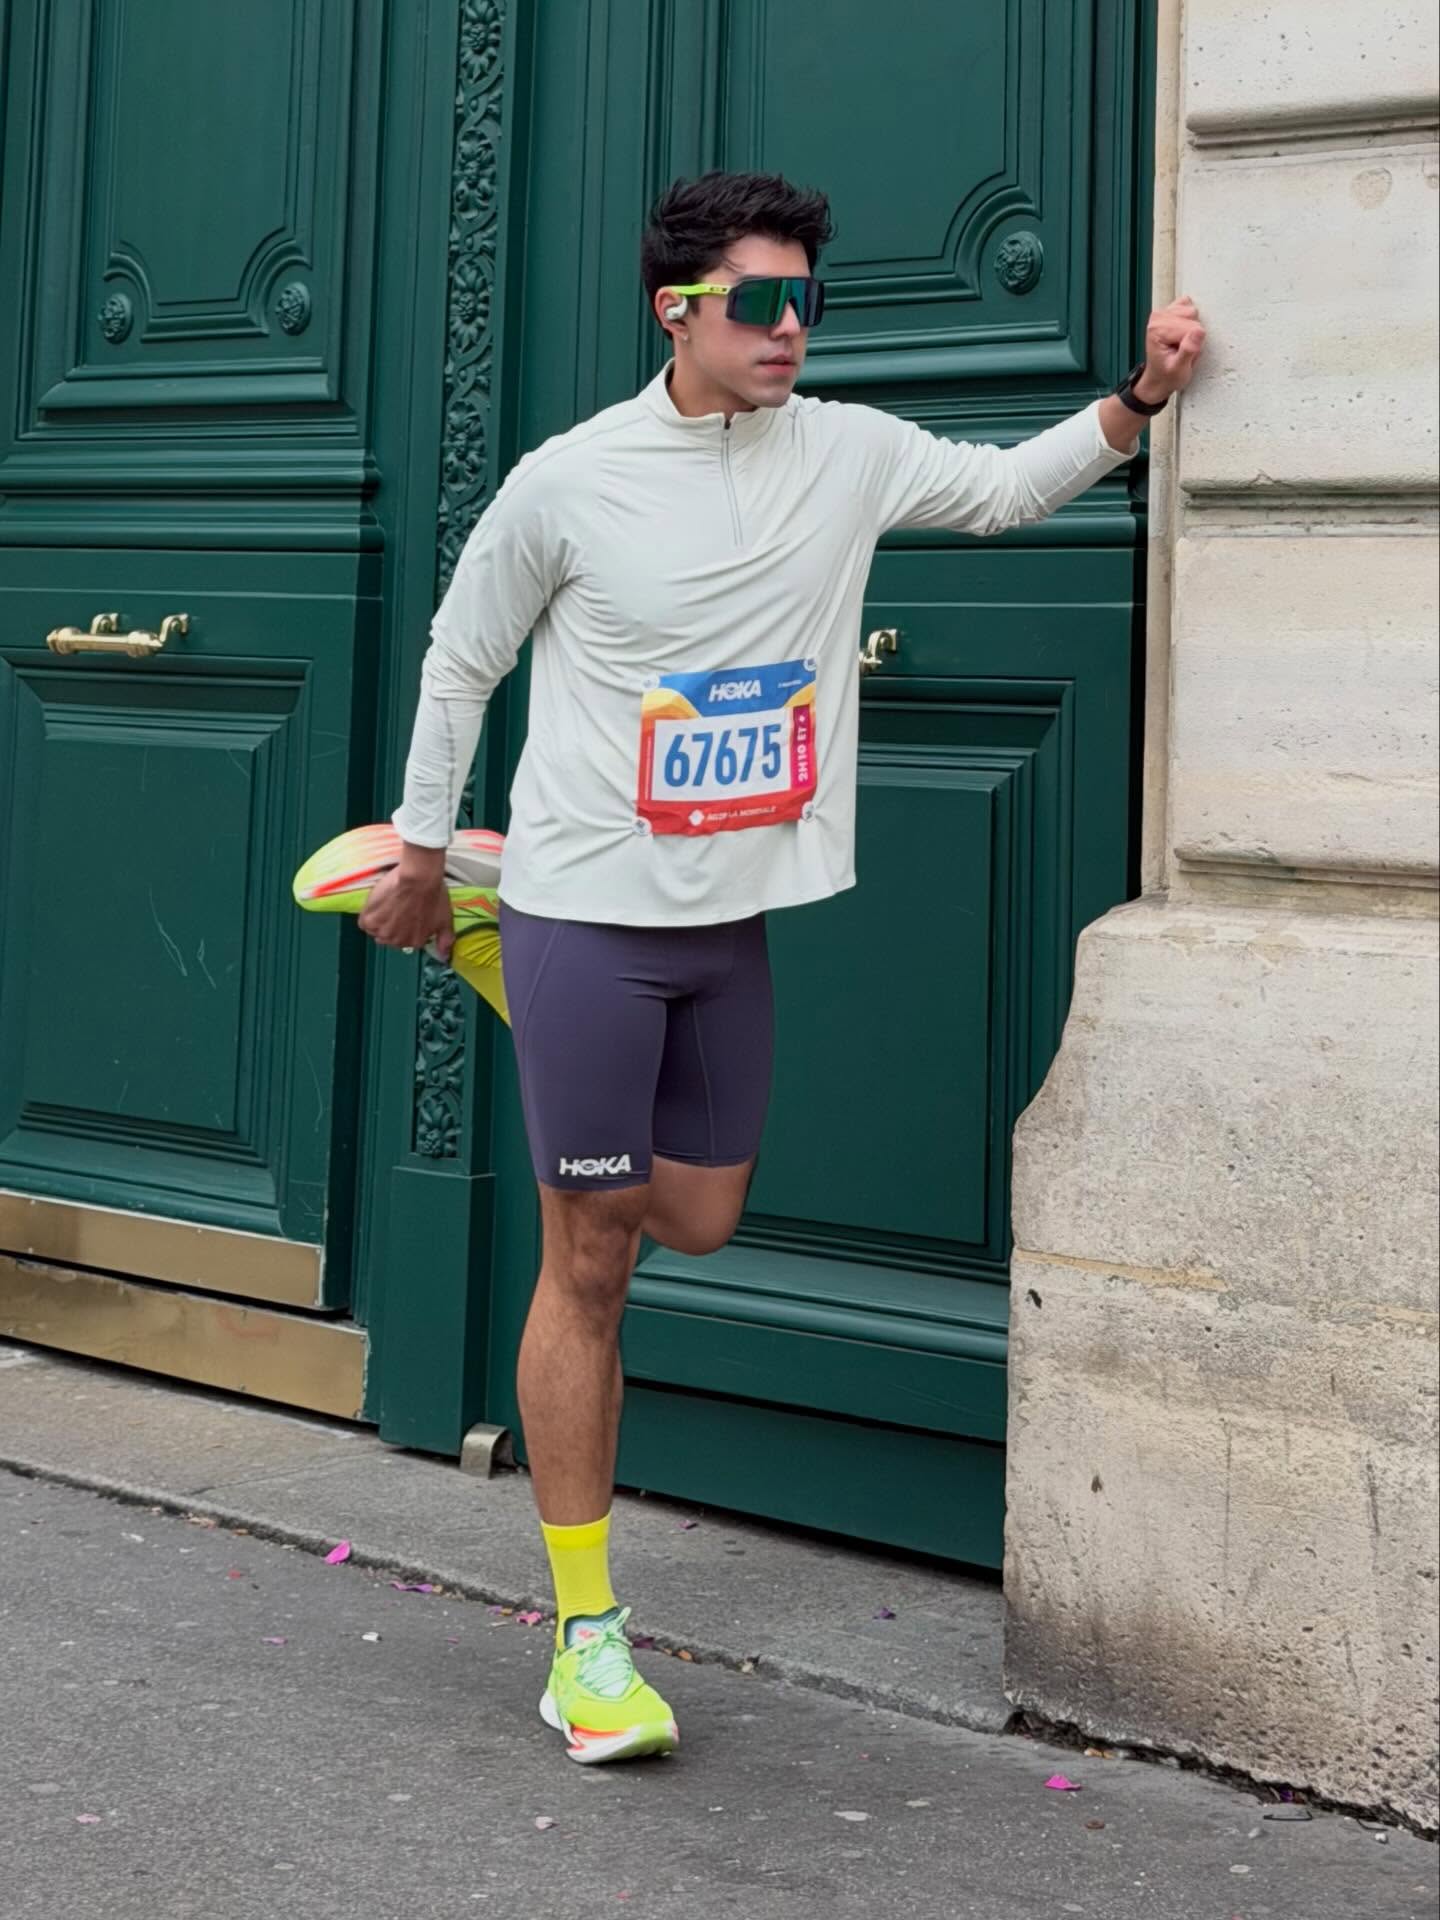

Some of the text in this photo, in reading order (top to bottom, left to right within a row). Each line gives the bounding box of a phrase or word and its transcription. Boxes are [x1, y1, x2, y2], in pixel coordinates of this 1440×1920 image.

[708, 679, 762, 703] HOKA
[797, 727, 807, 741] ET
[664, 723, 782, 788] 67675
[797, 744, 808, 783] 2H10
[559, 1154, 632, 1176] HOKA
